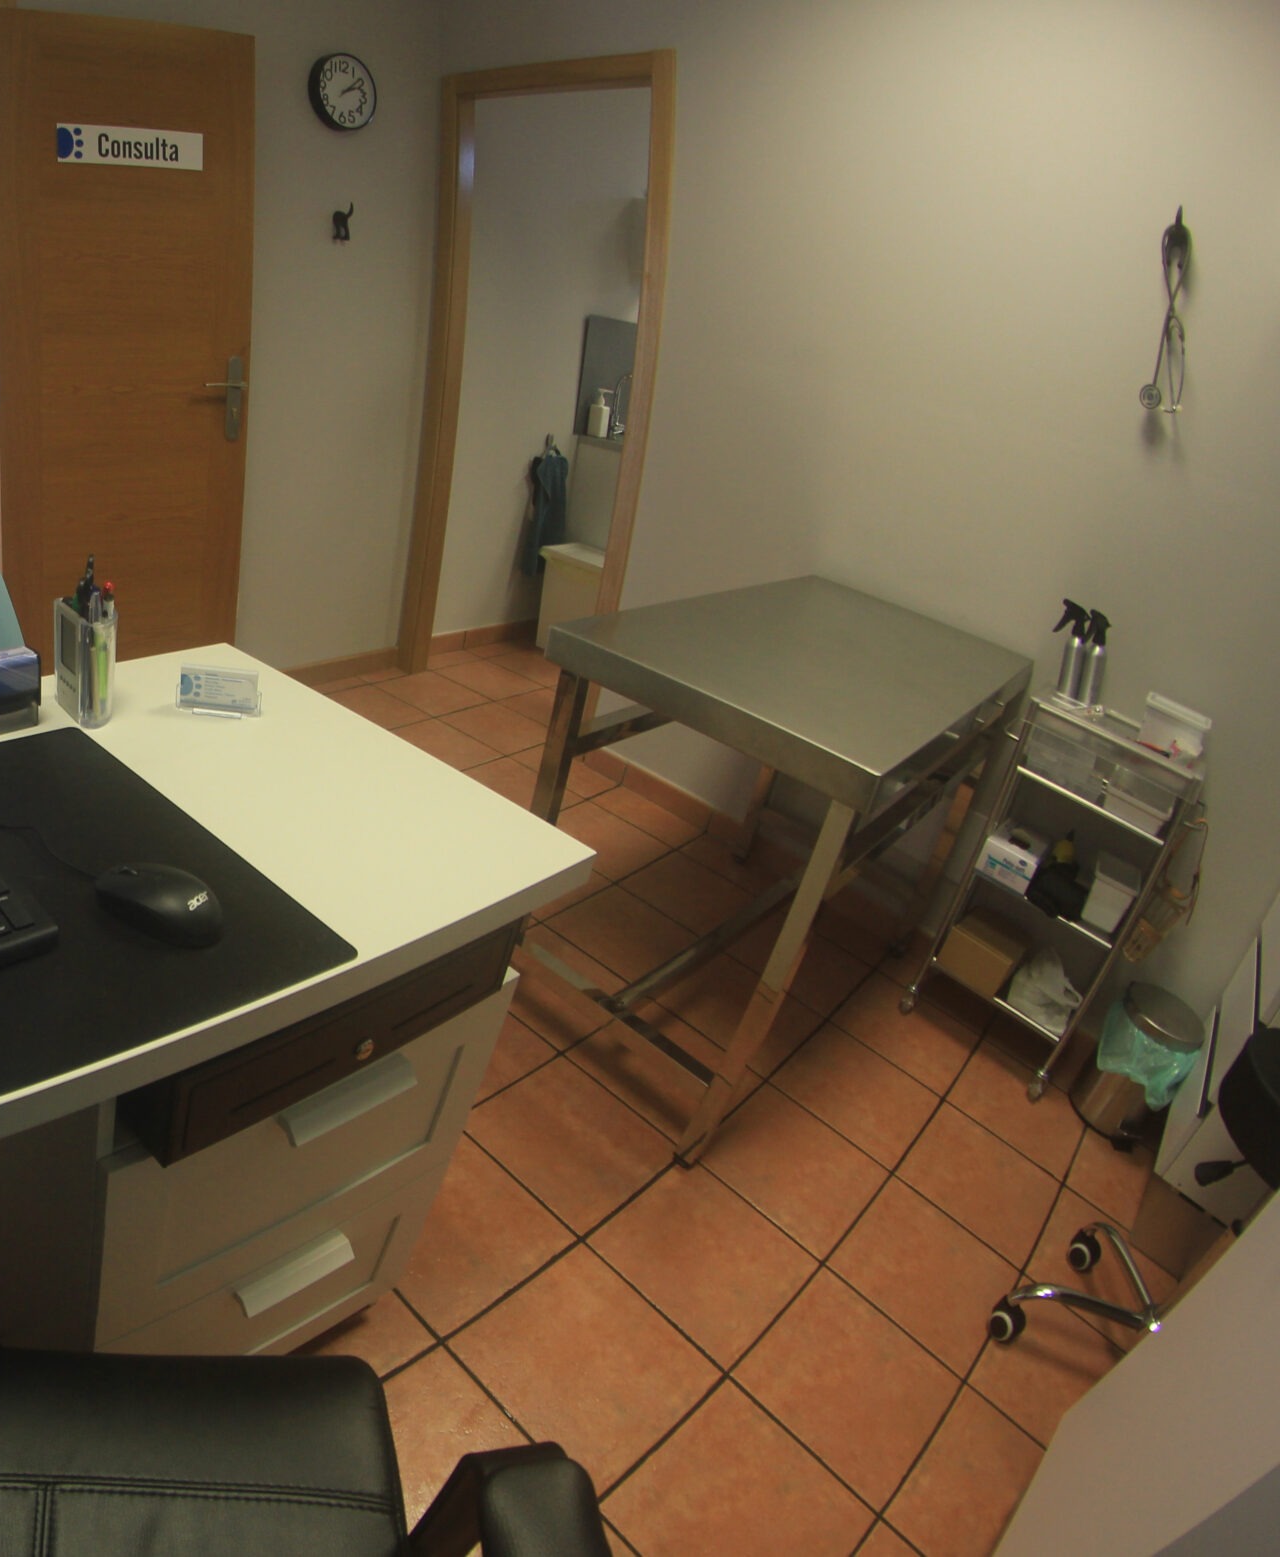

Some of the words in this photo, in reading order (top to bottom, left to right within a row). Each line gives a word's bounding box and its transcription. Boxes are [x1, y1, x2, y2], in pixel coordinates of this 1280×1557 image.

[338, 59, 349, 74] 12
[338, 111, 346, 124] 6
[348, 109, 356, 124] 5
[97, 133, 180, 162] Consulta
